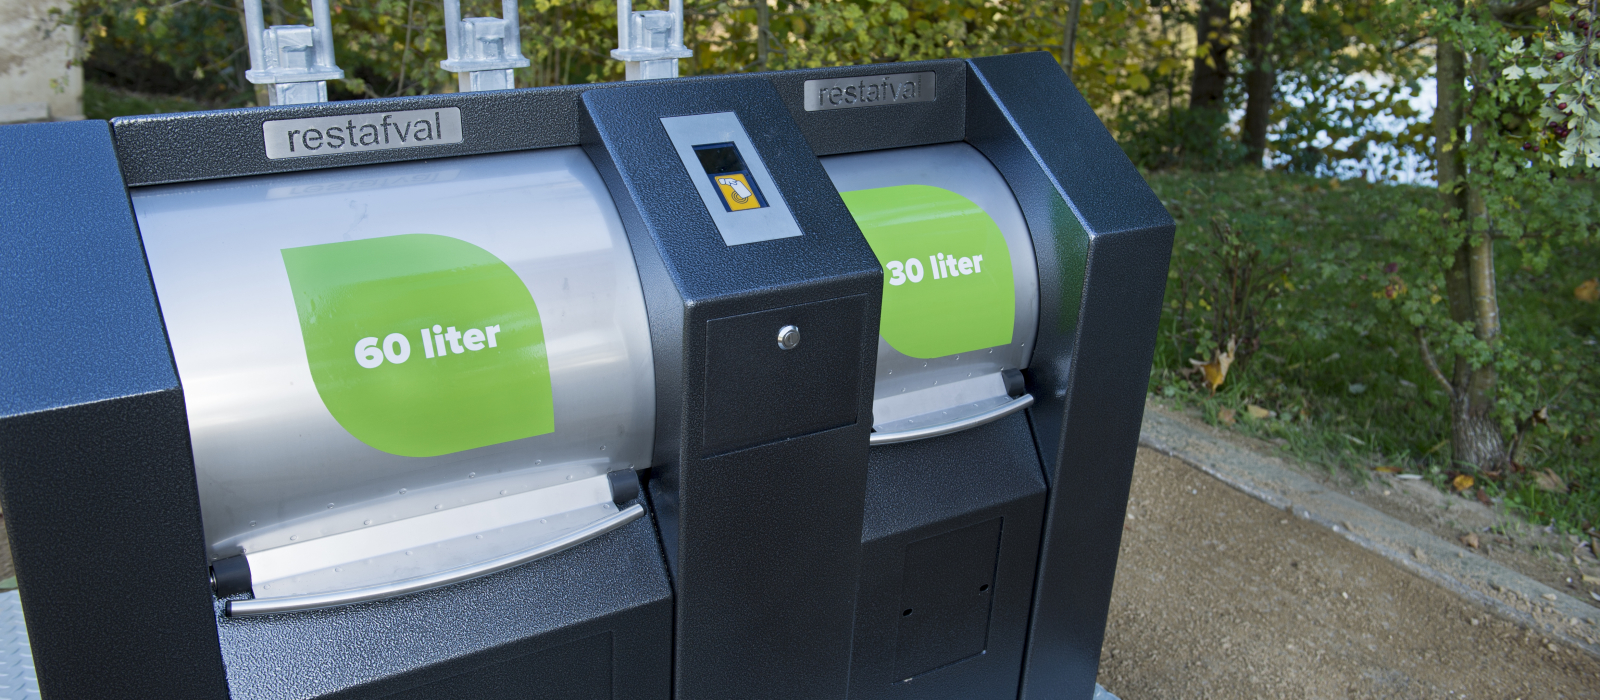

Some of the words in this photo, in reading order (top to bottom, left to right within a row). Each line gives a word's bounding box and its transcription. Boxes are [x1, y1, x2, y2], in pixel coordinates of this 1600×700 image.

[819, 75, 922, 106] restafval
[287, 112, 442, 152] restafval
[886, 258, 924, 286] 30
[929, 252, 983, 280] liter
[354, 333, 411, 369] 60
[420, 324, 501, 359] liter
